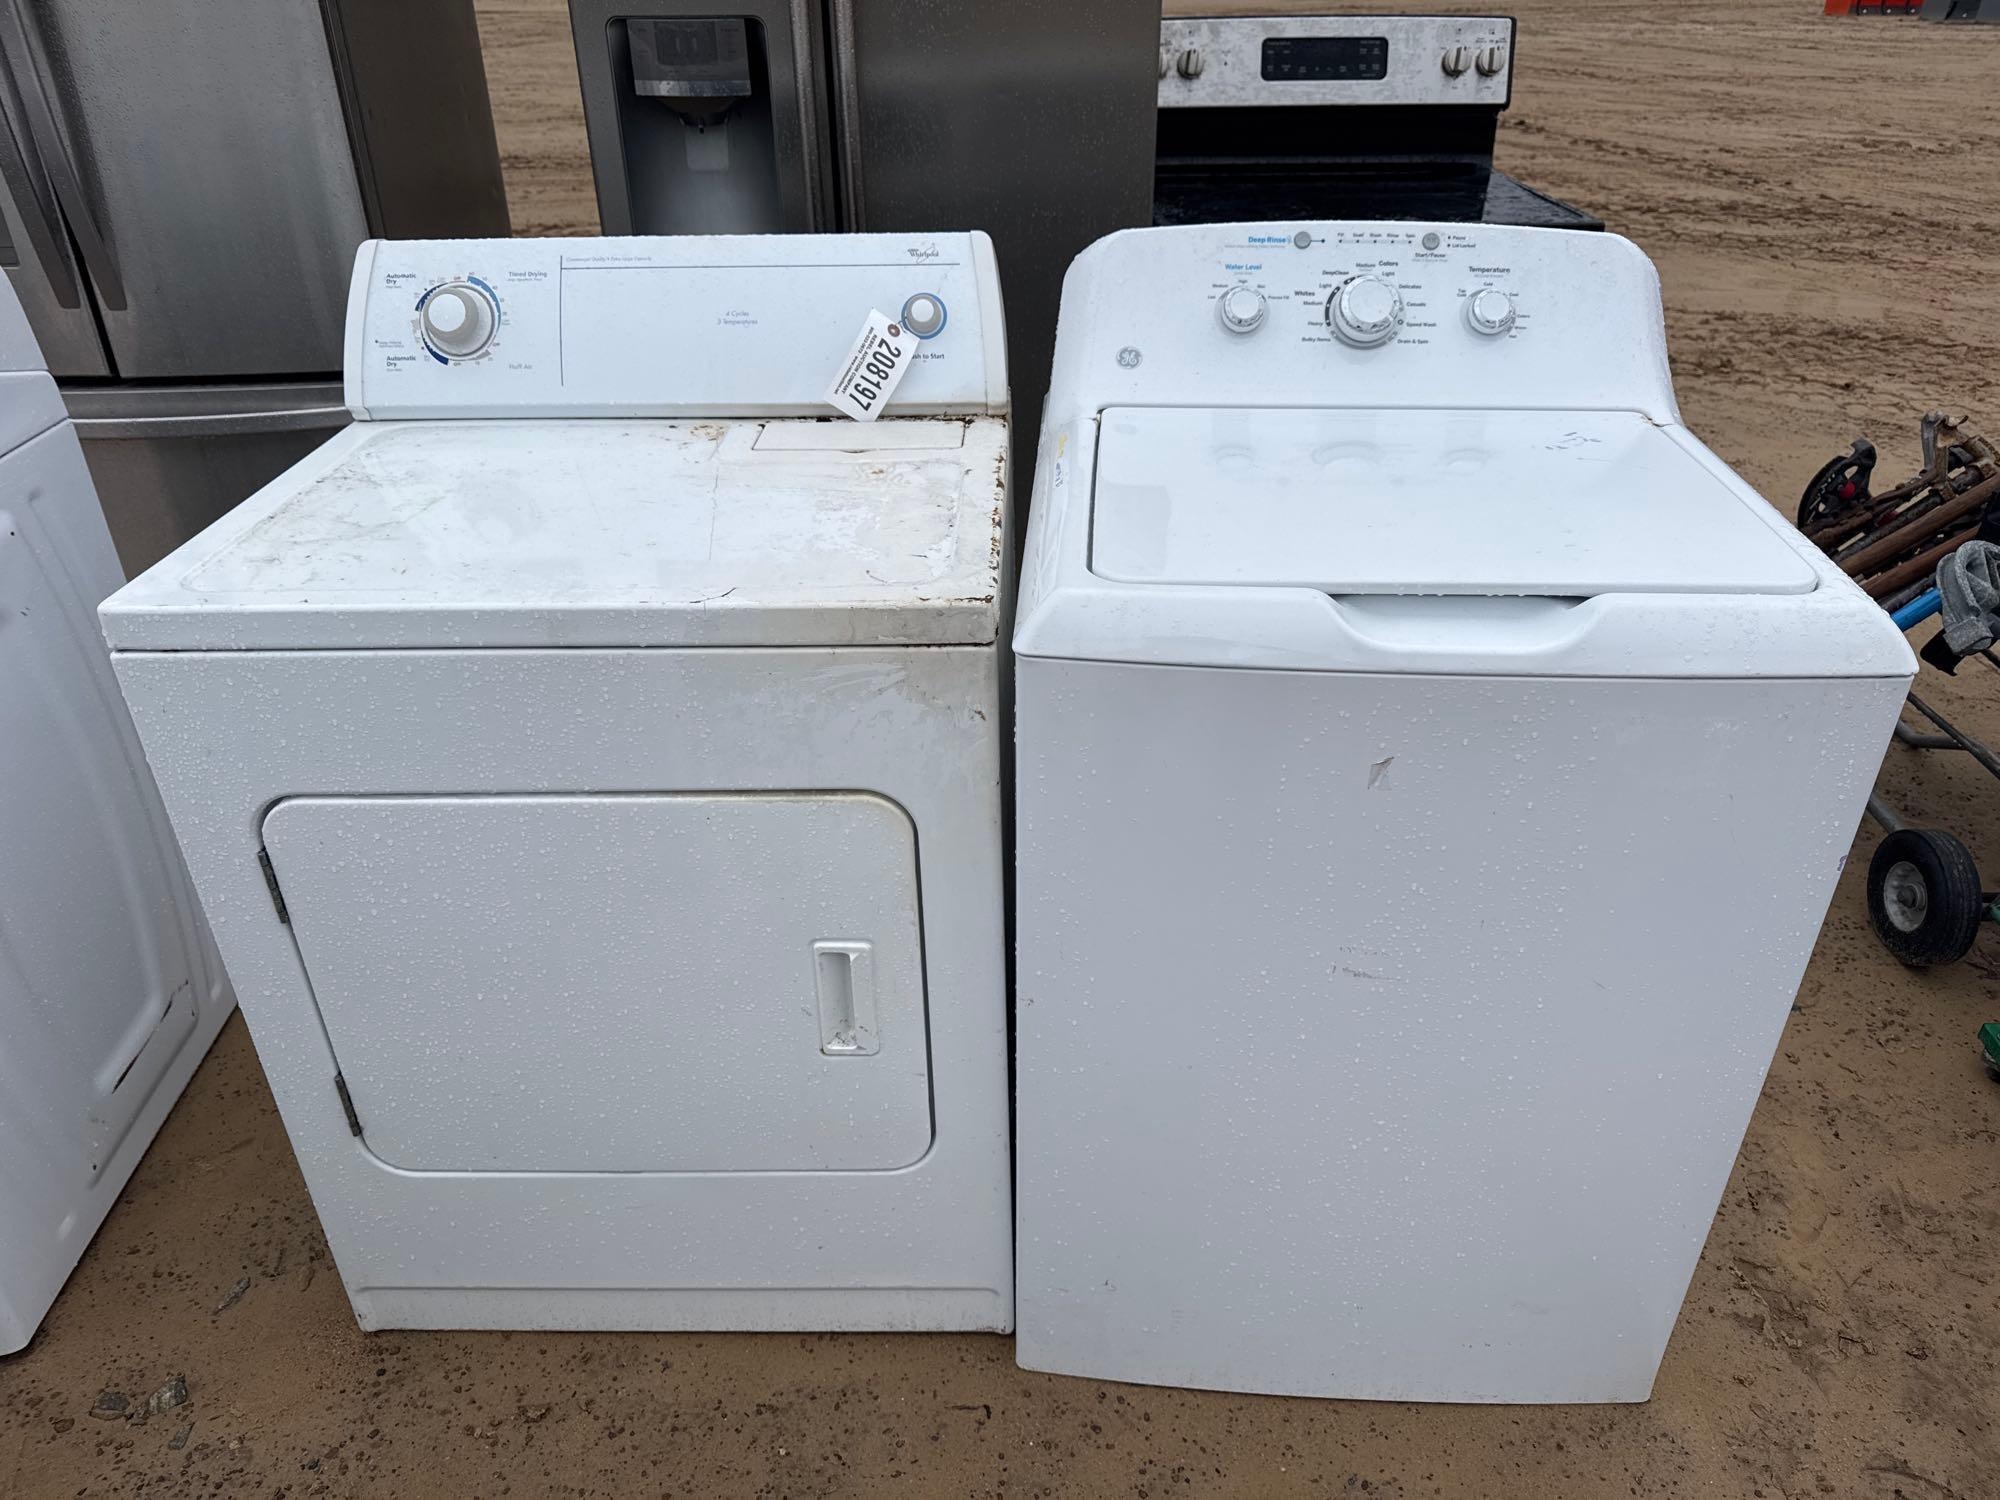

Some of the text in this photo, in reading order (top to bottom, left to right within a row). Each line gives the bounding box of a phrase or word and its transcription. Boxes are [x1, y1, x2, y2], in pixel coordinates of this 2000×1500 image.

[1248, 236, 1266, 244] Deep
[907, 249, 939, 259] Whirlpool
[1225, 263, 1262, 271] Water Level
[1468, 266, 1511, 275] Temperature
[528, 271, 548, 279] Drying
[841, 334, 878, 395] REBEL AUCTION COMPANY
[848, 338, 902, 412] 208197
